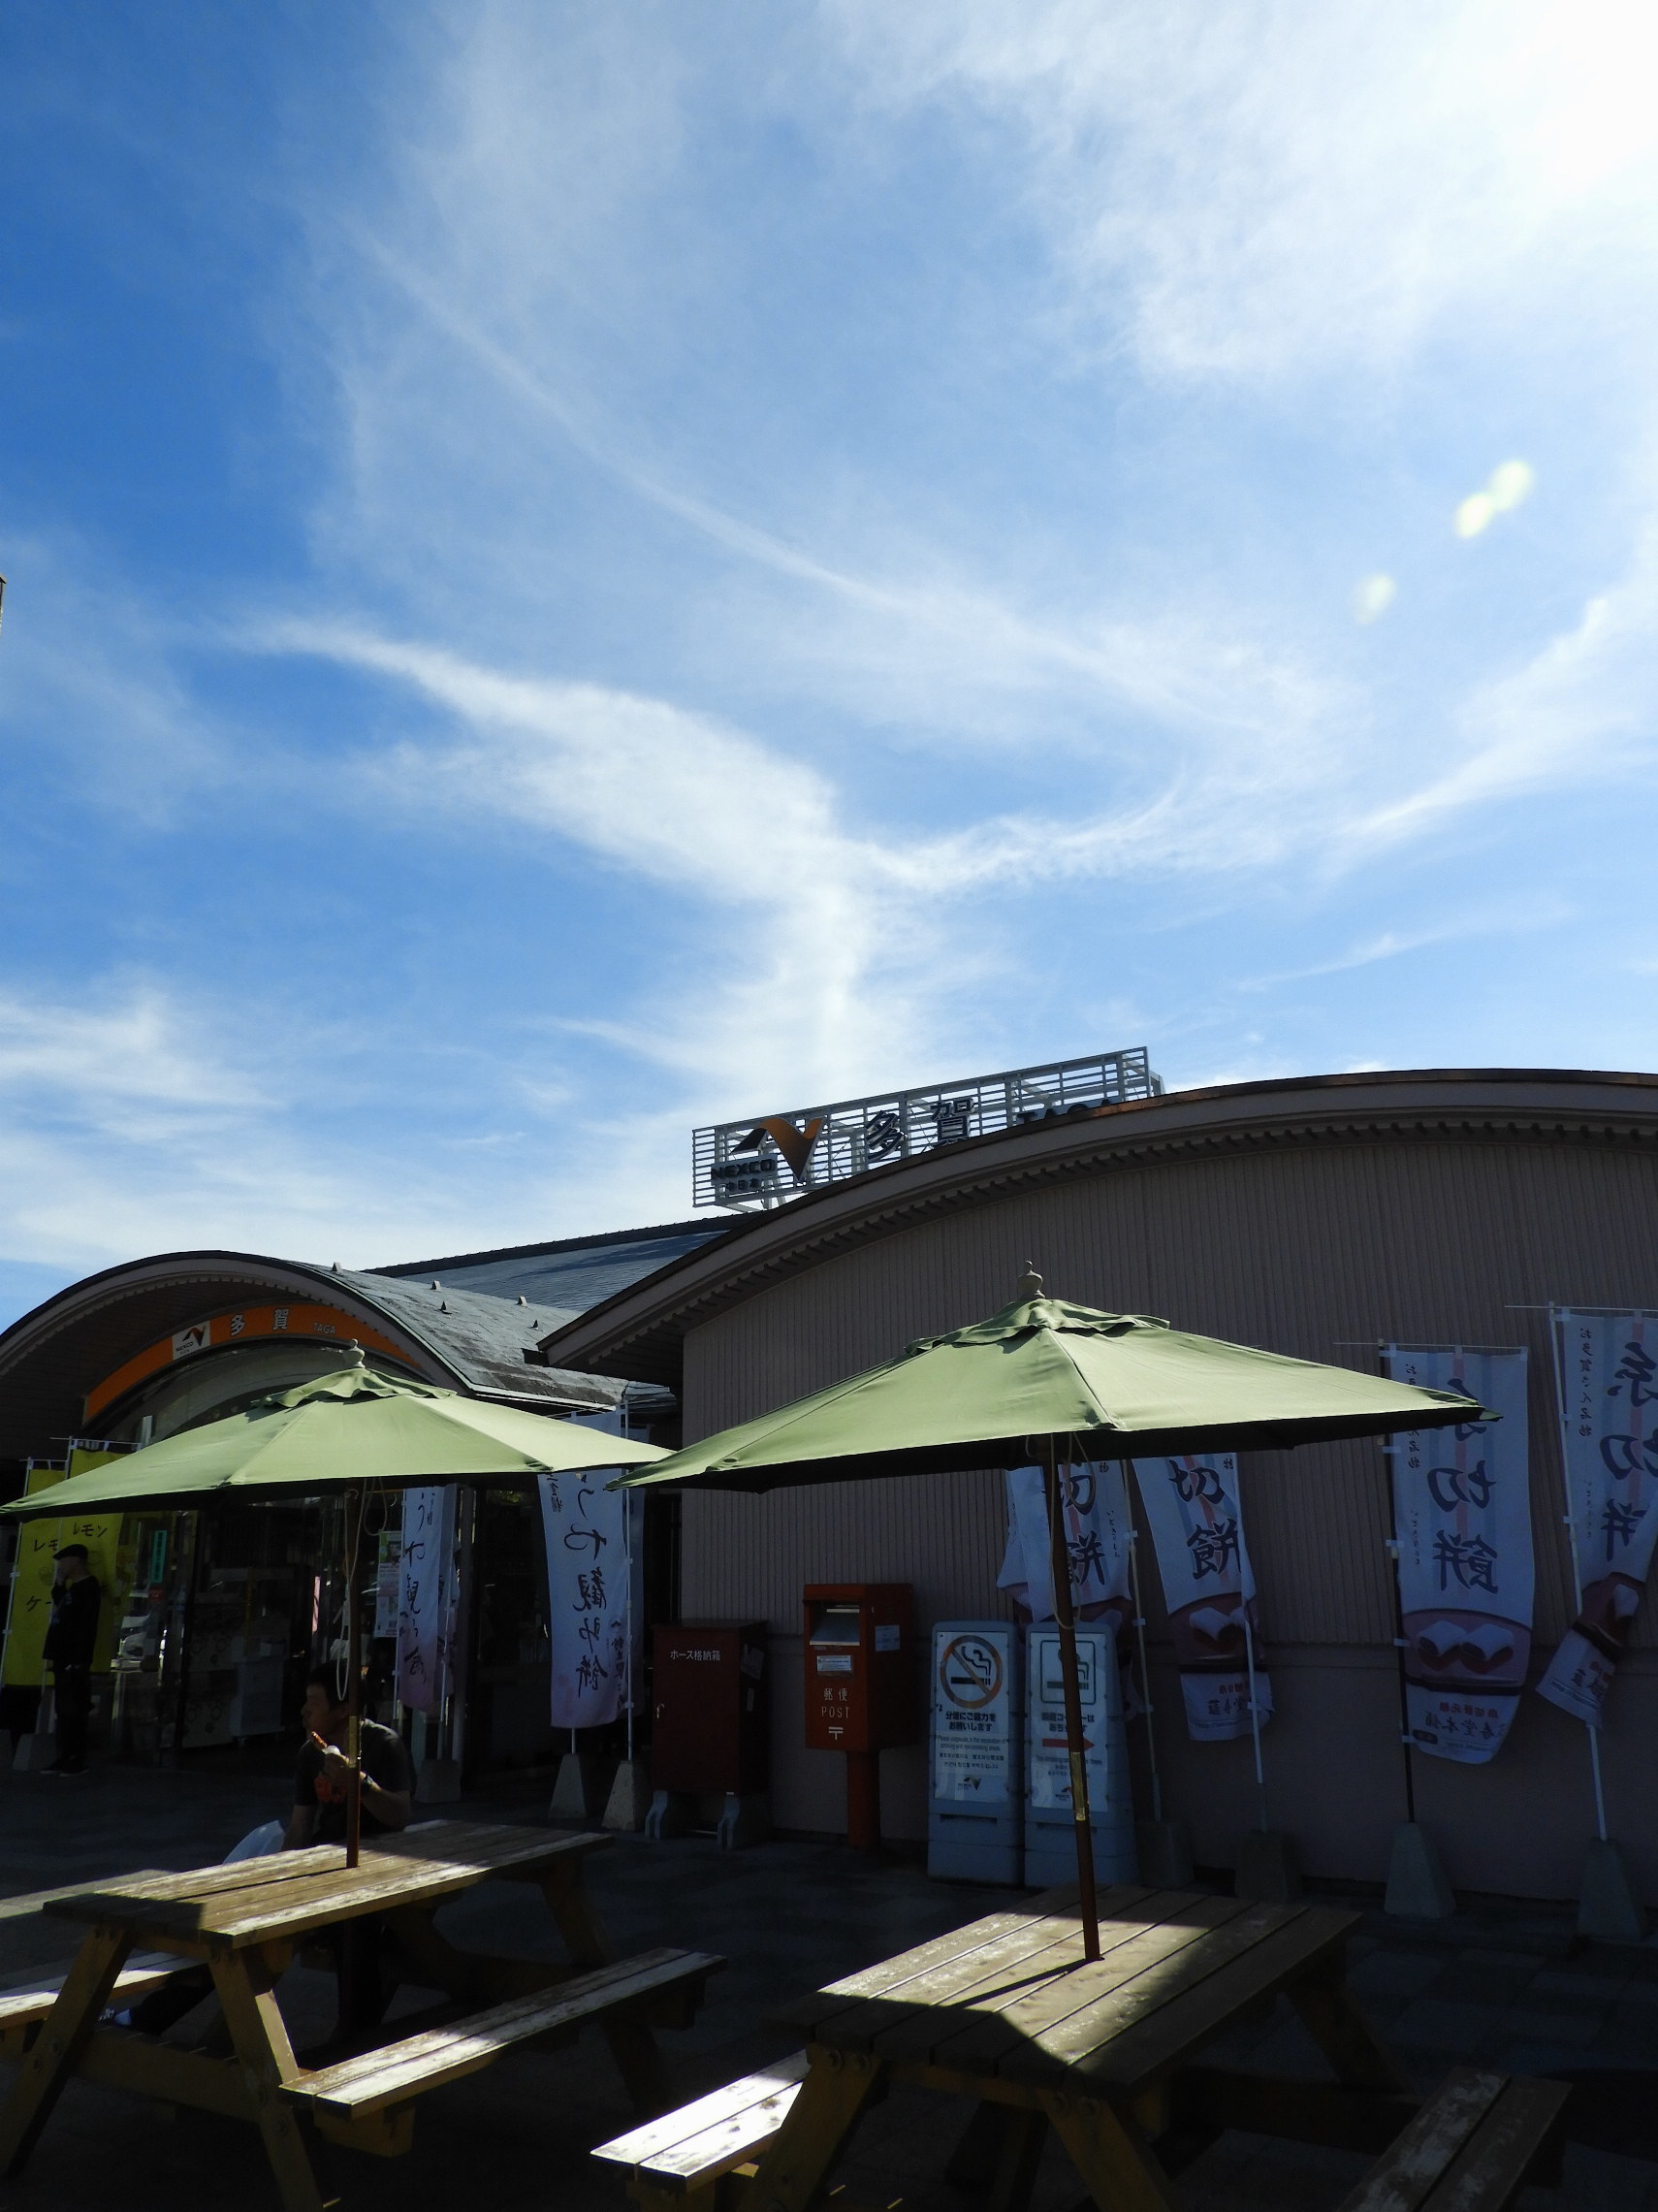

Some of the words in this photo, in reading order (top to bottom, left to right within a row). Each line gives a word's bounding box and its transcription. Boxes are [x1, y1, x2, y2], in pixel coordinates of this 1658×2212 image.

[864, 1097, 976, 1163] 多賀
[711, 1159, 777, 1180] NEXCO
[231, 1308, 290, 1336] 多賀
[313, 1322, 336, 1334] TAGA
[73, 1522, 108, 1538] レモン
[670, 1650, 721, 1662] ホース格納箱
[823, 1687, 848, 1703] 郵便
[821, 1706, 850, 1719] POST
